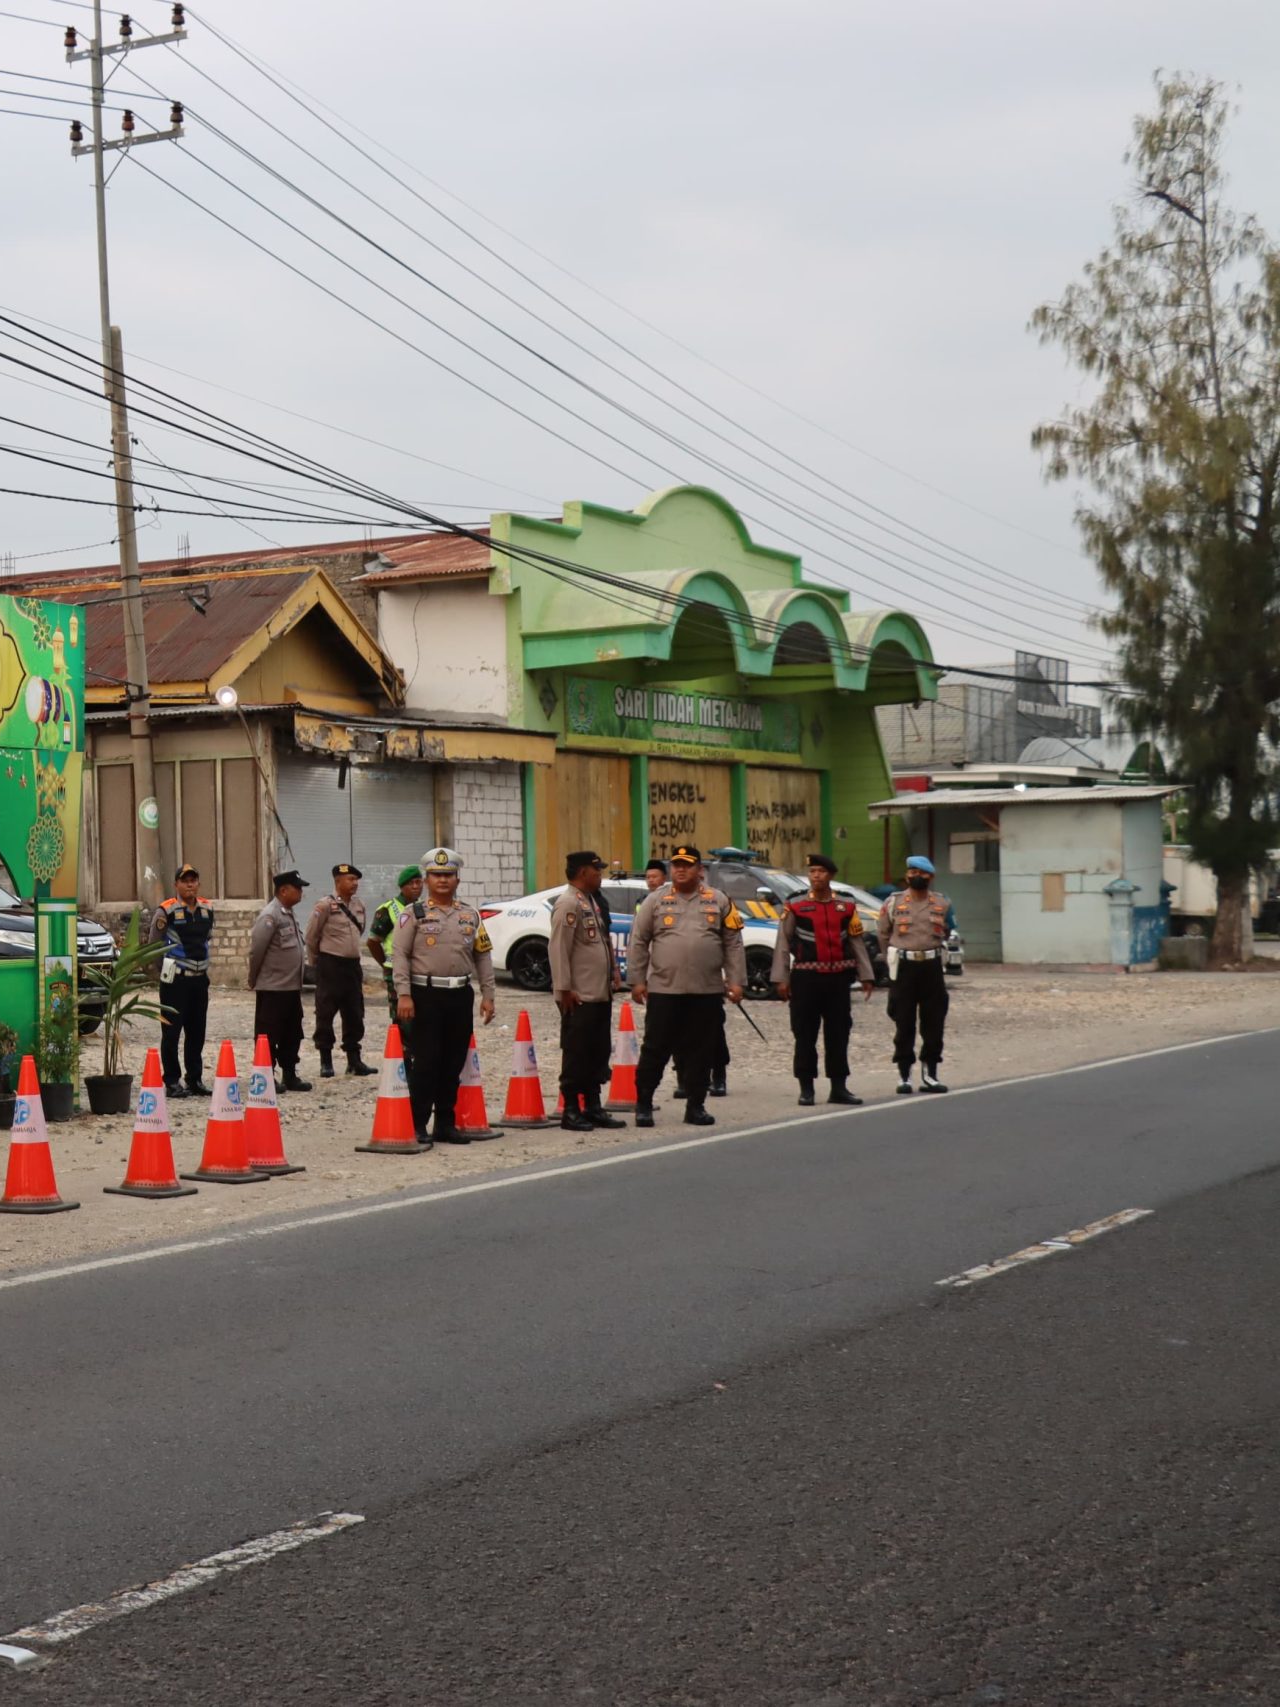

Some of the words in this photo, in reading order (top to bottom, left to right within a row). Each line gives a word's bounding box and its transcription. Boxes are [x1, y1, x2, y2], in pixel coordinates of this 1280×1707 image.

[613, 686, 649, 721] SARI
[652, 690, 695, 726] INDAH
[698, 697, 764, 732] METAJAYA
[648, 782, 706, 806] ENGKEL
